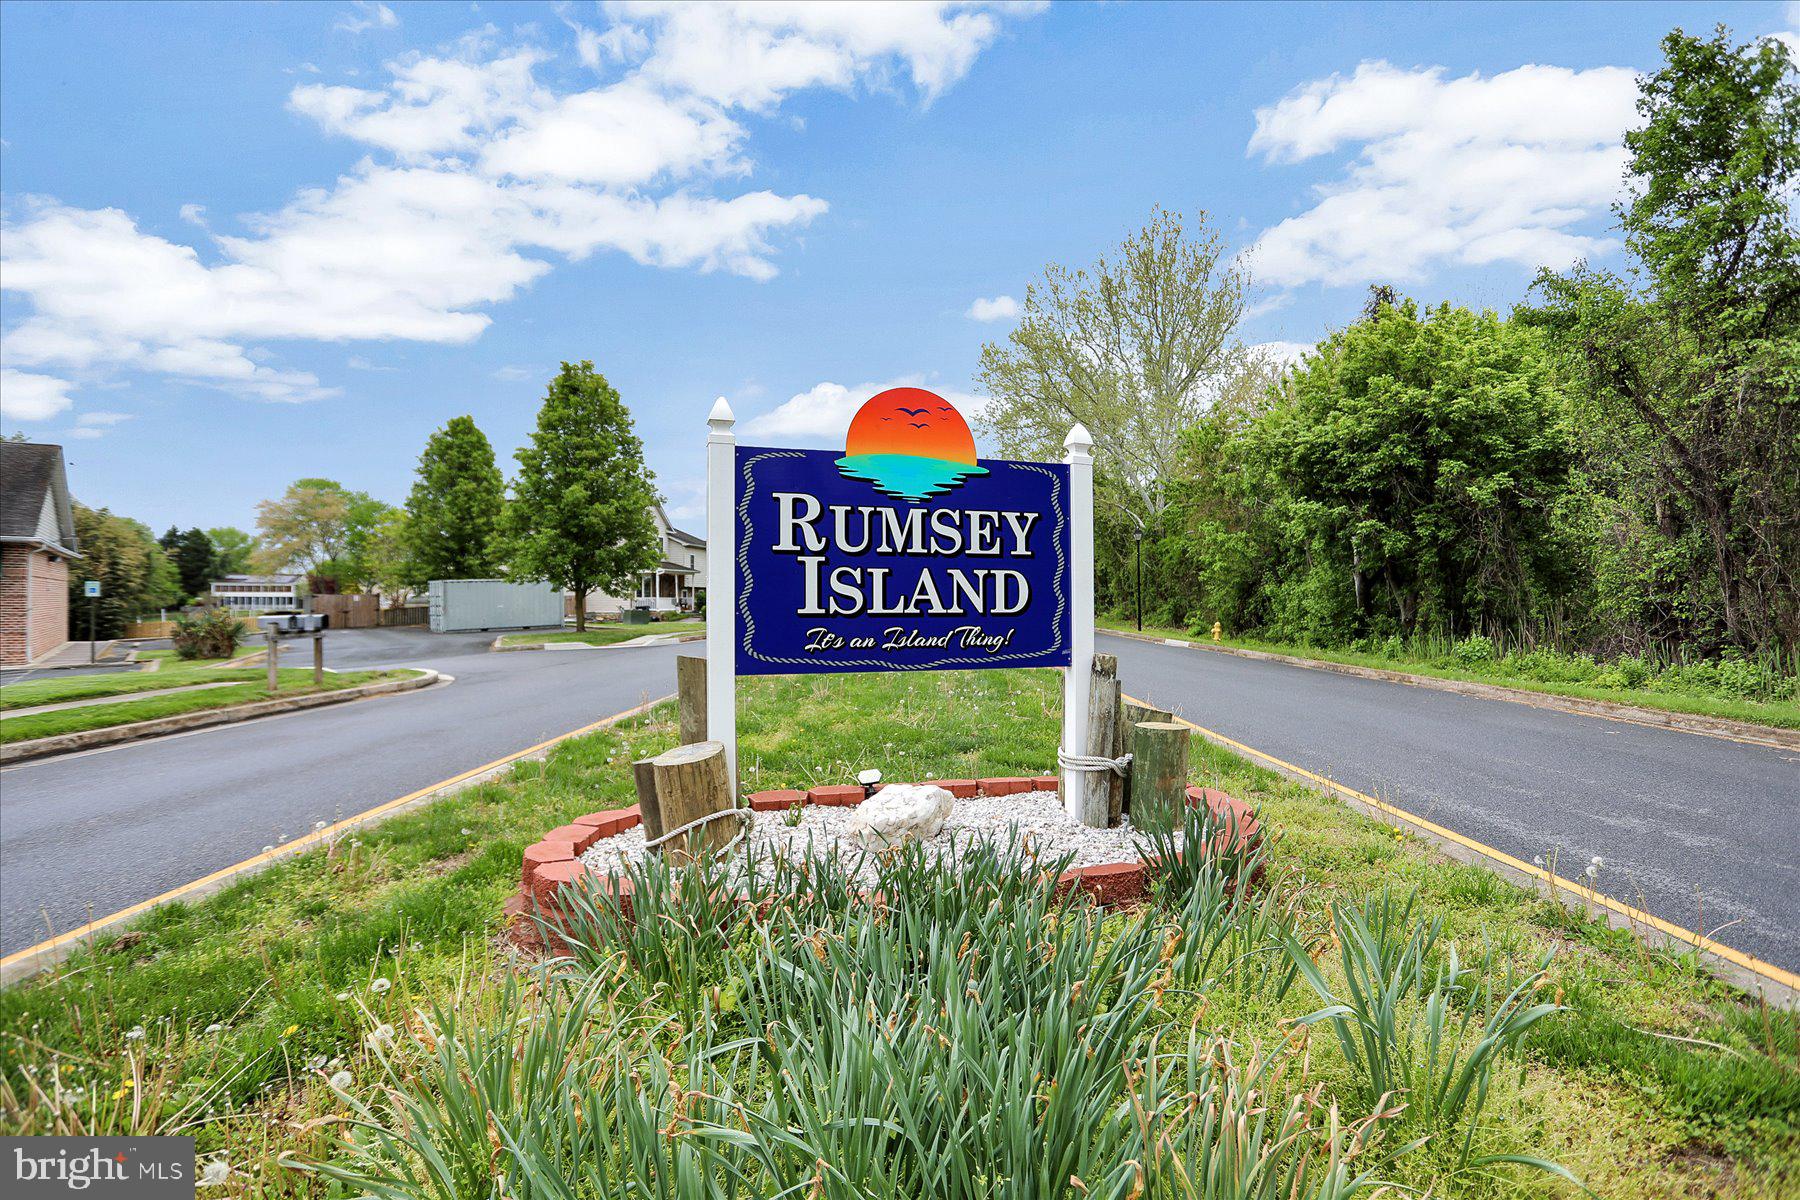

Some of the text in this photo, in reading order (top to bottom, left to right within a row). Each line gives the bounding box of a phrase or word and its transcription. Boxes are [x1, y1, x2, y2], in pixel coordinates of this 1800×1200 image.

[772, 492, 1039, 556] RUMSEY
[797, 555, 1030, 615] ISLAND
[849, 637, 876, 648] an
[881, 626, 954, 651] Island
[954, 625, 1015, 653] Thing!
